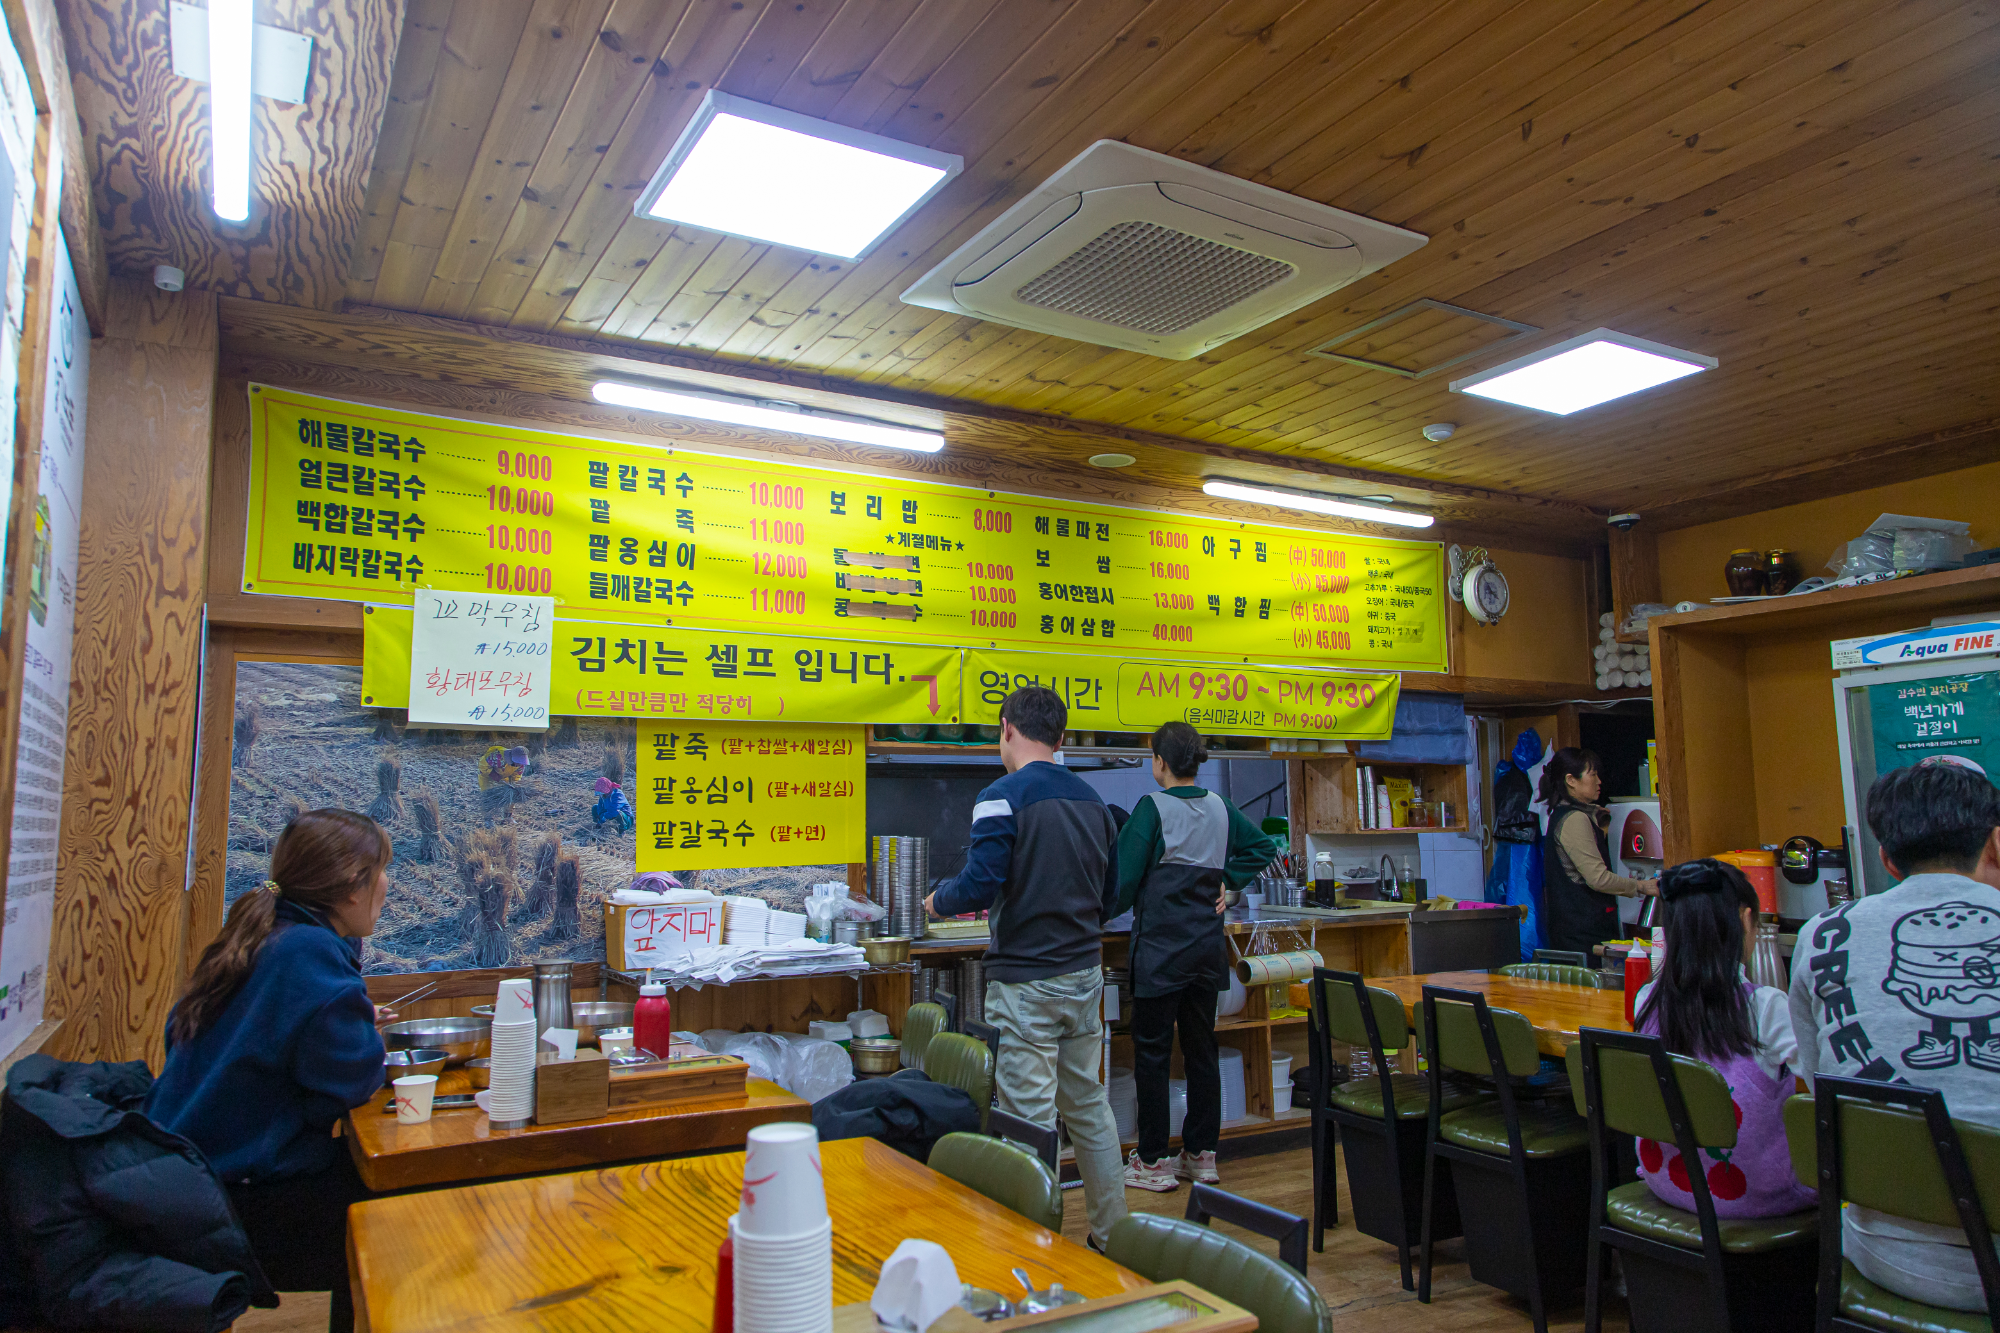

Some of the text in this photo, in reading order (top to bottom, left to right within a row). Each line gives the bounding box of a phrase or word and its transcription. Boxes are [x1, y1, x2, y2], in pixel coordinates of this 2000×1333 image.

[298, 418, 552, 481] 해물칼국수 9,000
[298, 458, 554, 517] 얼큰칼국수 10,000
[749, 481, 804, 510] 10,000
[296, 500, 552, 556] 백합칼국수 10,000
[750, 517, 804, 546] 11,000
[973, 508, 1012, 534] 8,000
[1149, 530, 1189, 549] 16,000
[293, 542, 552, 594] 바지락칼국수 10,000
[752, 552, 808, 580] 12,000
[967, 562, 1014, 582] 10,000
[1150, 561, 1190, 580] 16,000
[1311, 548, 1346, 569] 50,000
[589, 571, 694, 607] 들깨칼국수
[750, 587, 806, 615] 11,000
[969, 585, 1016, 604] 10,000
[1038, 582, 1194, 610] 홍어한접시 13,000
[1315, 575, 1350, 594] 45,000
[970, 609, 1017, 629] 10,000
[1312, 603, 1349, 624] 50,000
[1152, 624, 1193, 642] 40,000
[1316, 630, 1351, 651] 45,000
[1900, 634, 1994, 658] Aqua FINE
[570, 636, 905, 685] 김치는 셀프 입니다.
[426, 666, 532, 698] 황태포무침
[1136, 671, 1180, 698] AM
[1189, 672, 1248, 702] 9:30
[1278, 680, 1314, 706] PM
[1322, 680, 1376, 709] 9:30
[576, 688, 688, 714] (드실만큼만
[696, 694, 752, 716] 적당히
[1904, 700, 1964, 719] 백년가게
[1184, 708, 1338, 730] (음식마감시간 PM 9:00)
[653, 776, 854, 805] 팥옹심이 (팥+새알심)
[653, 820, 826, 849] 팥칼국수 (팥+면)
